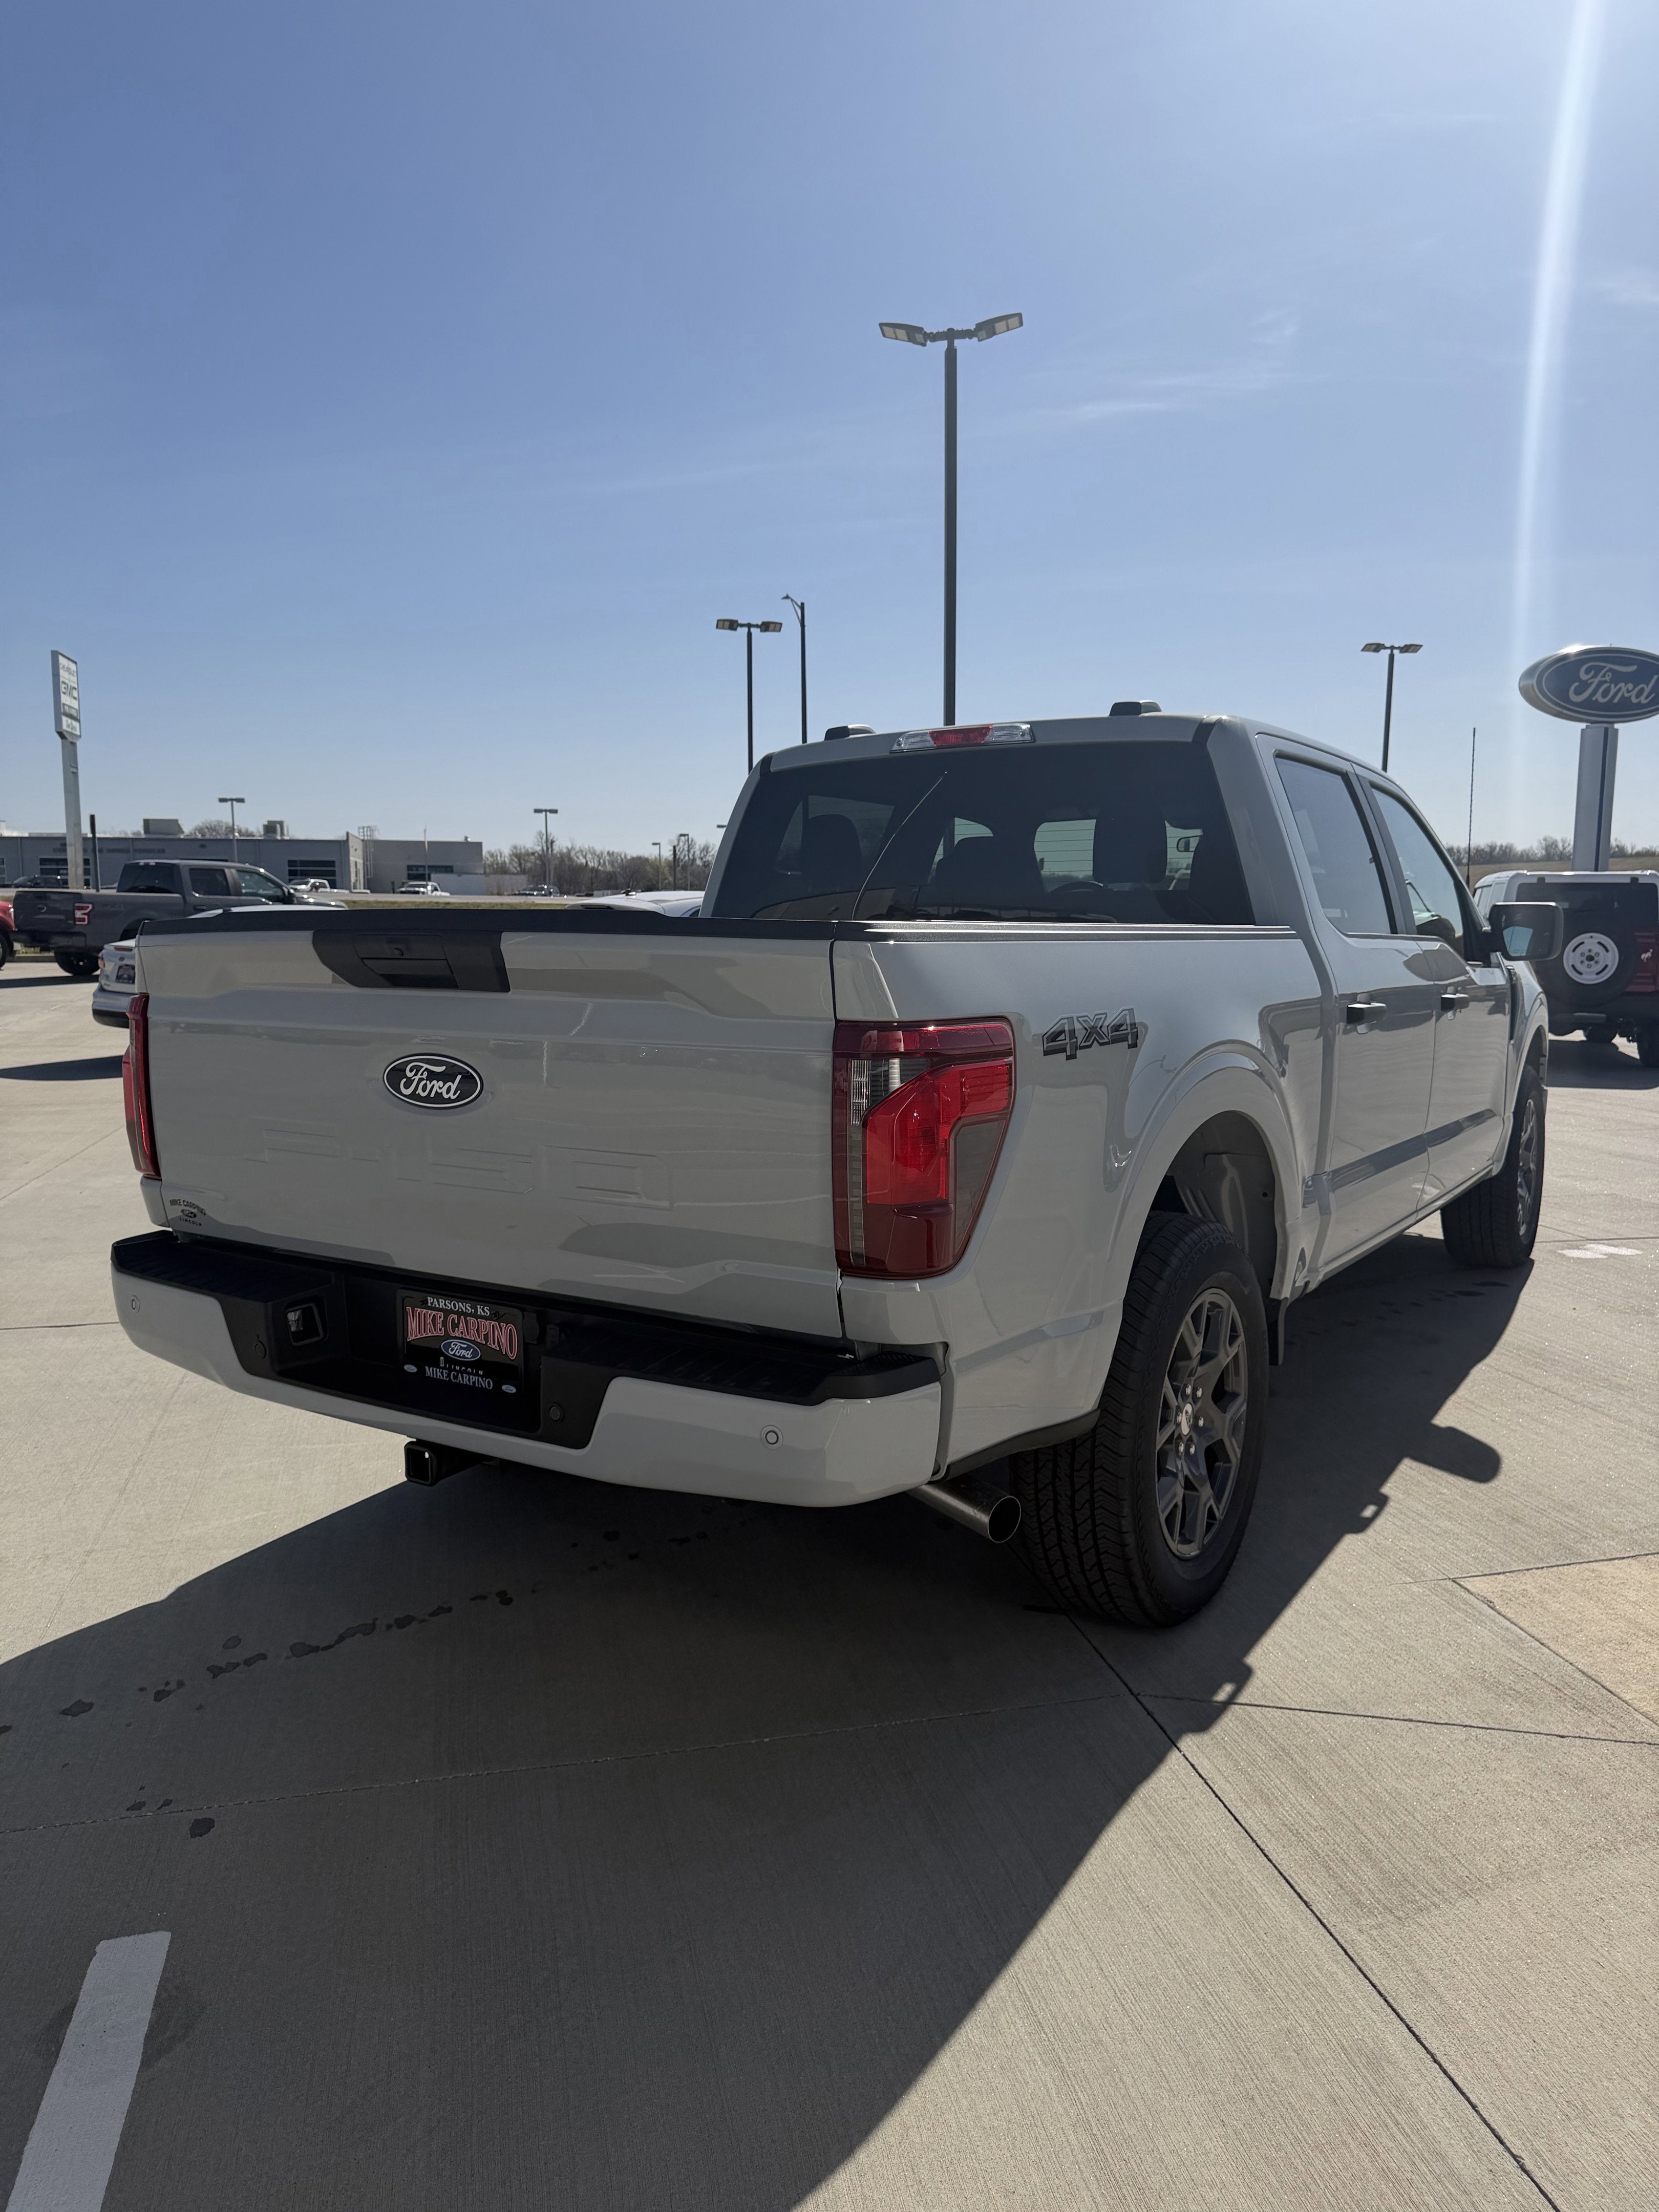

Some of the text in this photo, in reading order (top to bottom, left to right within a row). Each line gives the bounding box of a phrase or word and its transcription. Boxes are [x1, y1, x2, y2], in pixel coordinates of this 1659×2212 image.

[61, 680, 78, 700] GMC
[1568, 662, 1659, 704] Ford
[400, 1062, 462, 1099] Ford
[427, 1296, 490, 1317] PARSONS, KS
[406, 1306, 518, 1360] MIKE CARPINO
[449, 1341, 473, 1359] Ford
[425, 1366, 493, 1390] MIKE CARPINO
